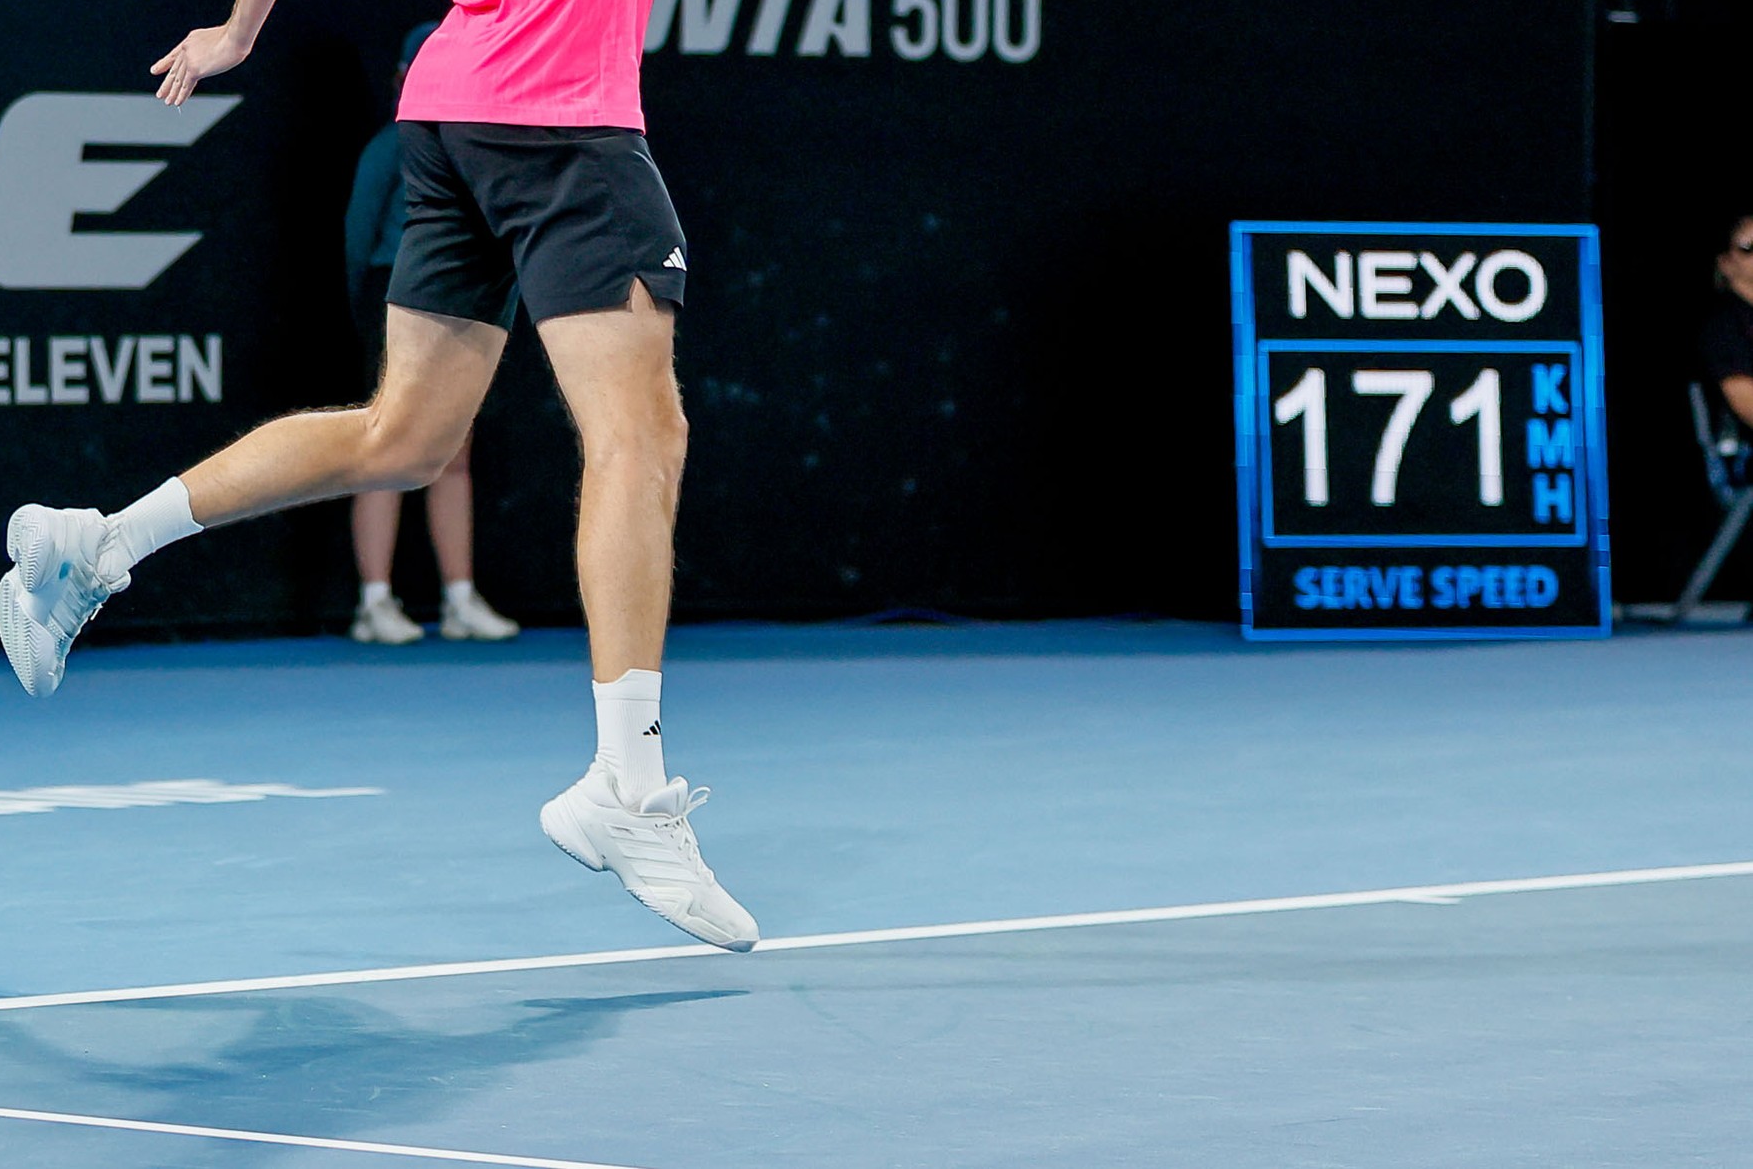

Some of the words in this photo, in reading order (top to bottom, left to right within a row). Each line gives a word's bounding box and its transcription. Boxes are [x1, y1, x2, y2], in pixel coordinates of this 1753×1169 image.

[1286, 249, 1548, 323] NEXO
[1274, 367, 1504, 507] 171
[1526, 362, 1576, 524] KMH
[1293, 567, 1425, 610] SERVE
[1430, 564, 1560, 609] SPEED
